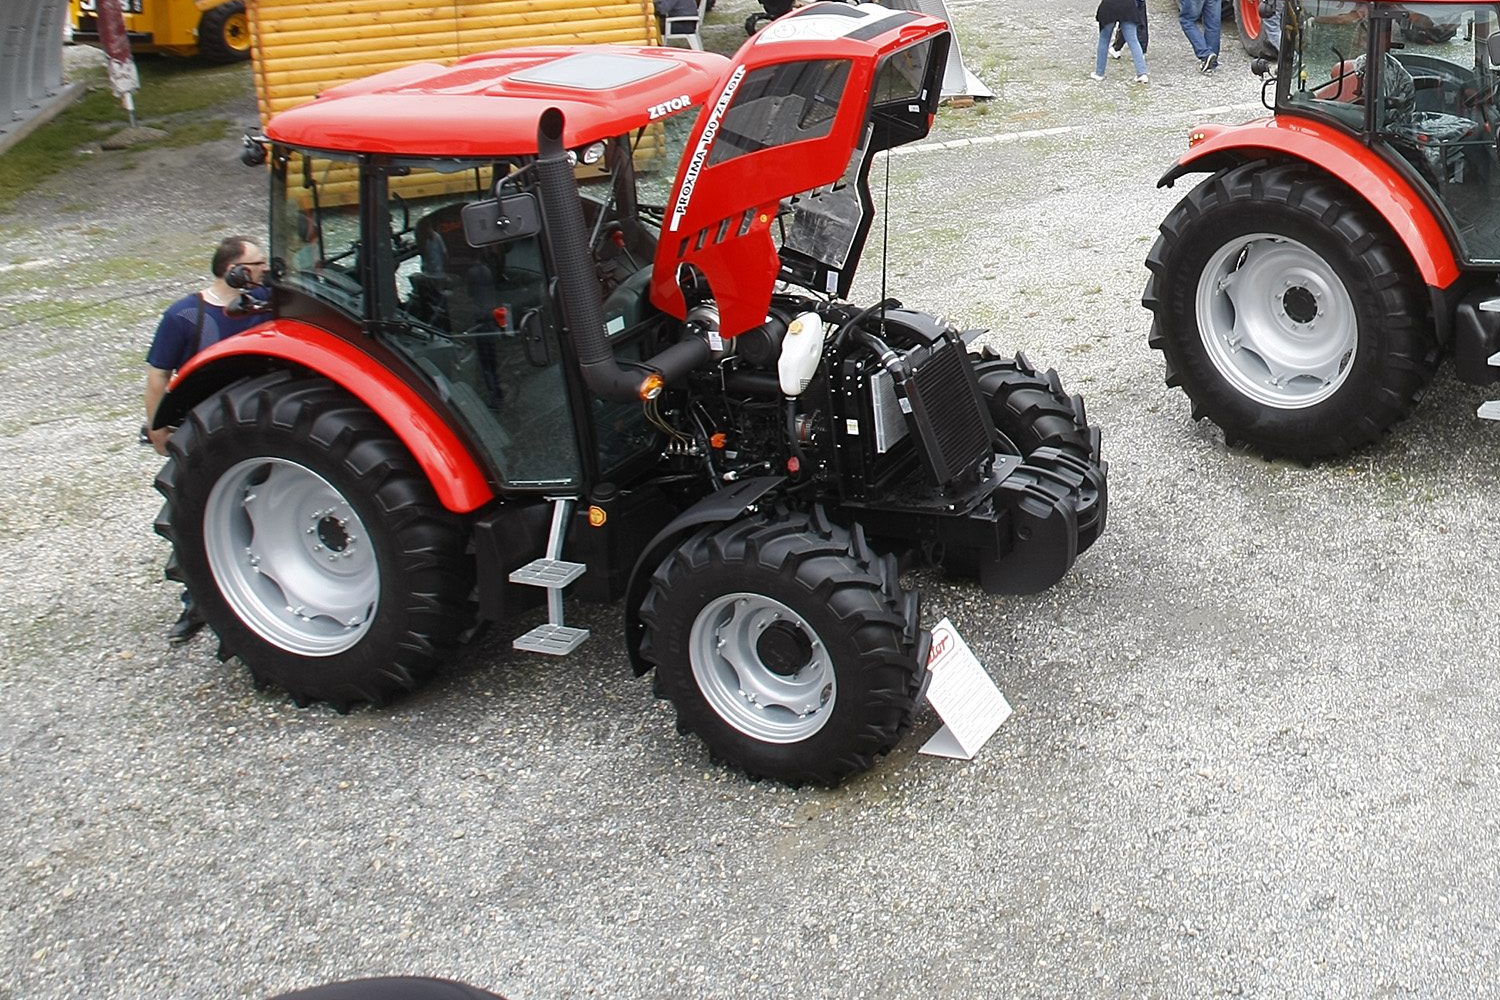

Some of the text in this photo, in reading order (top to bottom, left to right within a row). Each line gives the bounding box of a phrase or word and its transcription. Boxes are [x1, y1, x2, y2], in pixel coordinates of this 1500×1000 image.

[647, 94, 692, 120] ZETOR
[676, 69, 745, 215] PROXIMA 100 ZETOR
